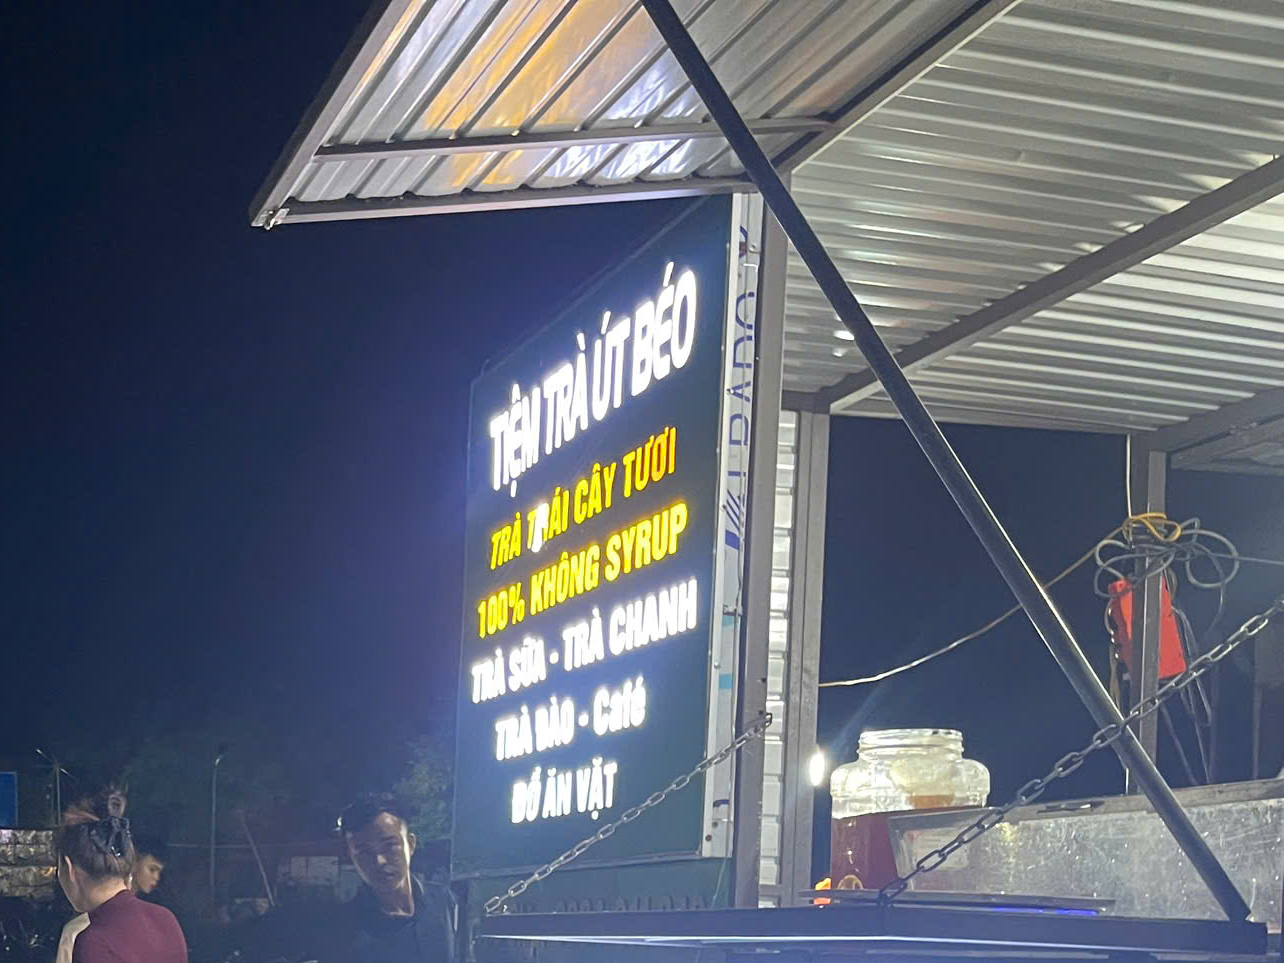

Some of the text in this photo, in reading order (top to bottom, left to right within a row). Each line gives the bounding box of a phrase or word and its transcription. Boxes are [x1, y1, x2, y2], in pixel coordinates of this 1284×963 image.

[489, 383, 541, 498] TIỆM
[543, 332, 588, 455] TRÀ
[592, 310, 631, 421] ÚT
[631, 261, 697, 397] BÉO
[490, 426, 677, 571] TRÀ TRÁI CÂY TƯƠI
[477, 501, 689, 639] 100% KHÔNG SYRUP
[471, 646, 506, 704] TRÀ
[508, 634, 547, 692] SỮA
[562, 607, 604, 671] TRÀ
[609, 576, 698, 656] CHANH
[495, 704, 533, 760] TRÀ
[593, 674, 647, 736] Café
[542, 767, 573, 818] ĂN
[576, 756, 618, 820] VẶT
